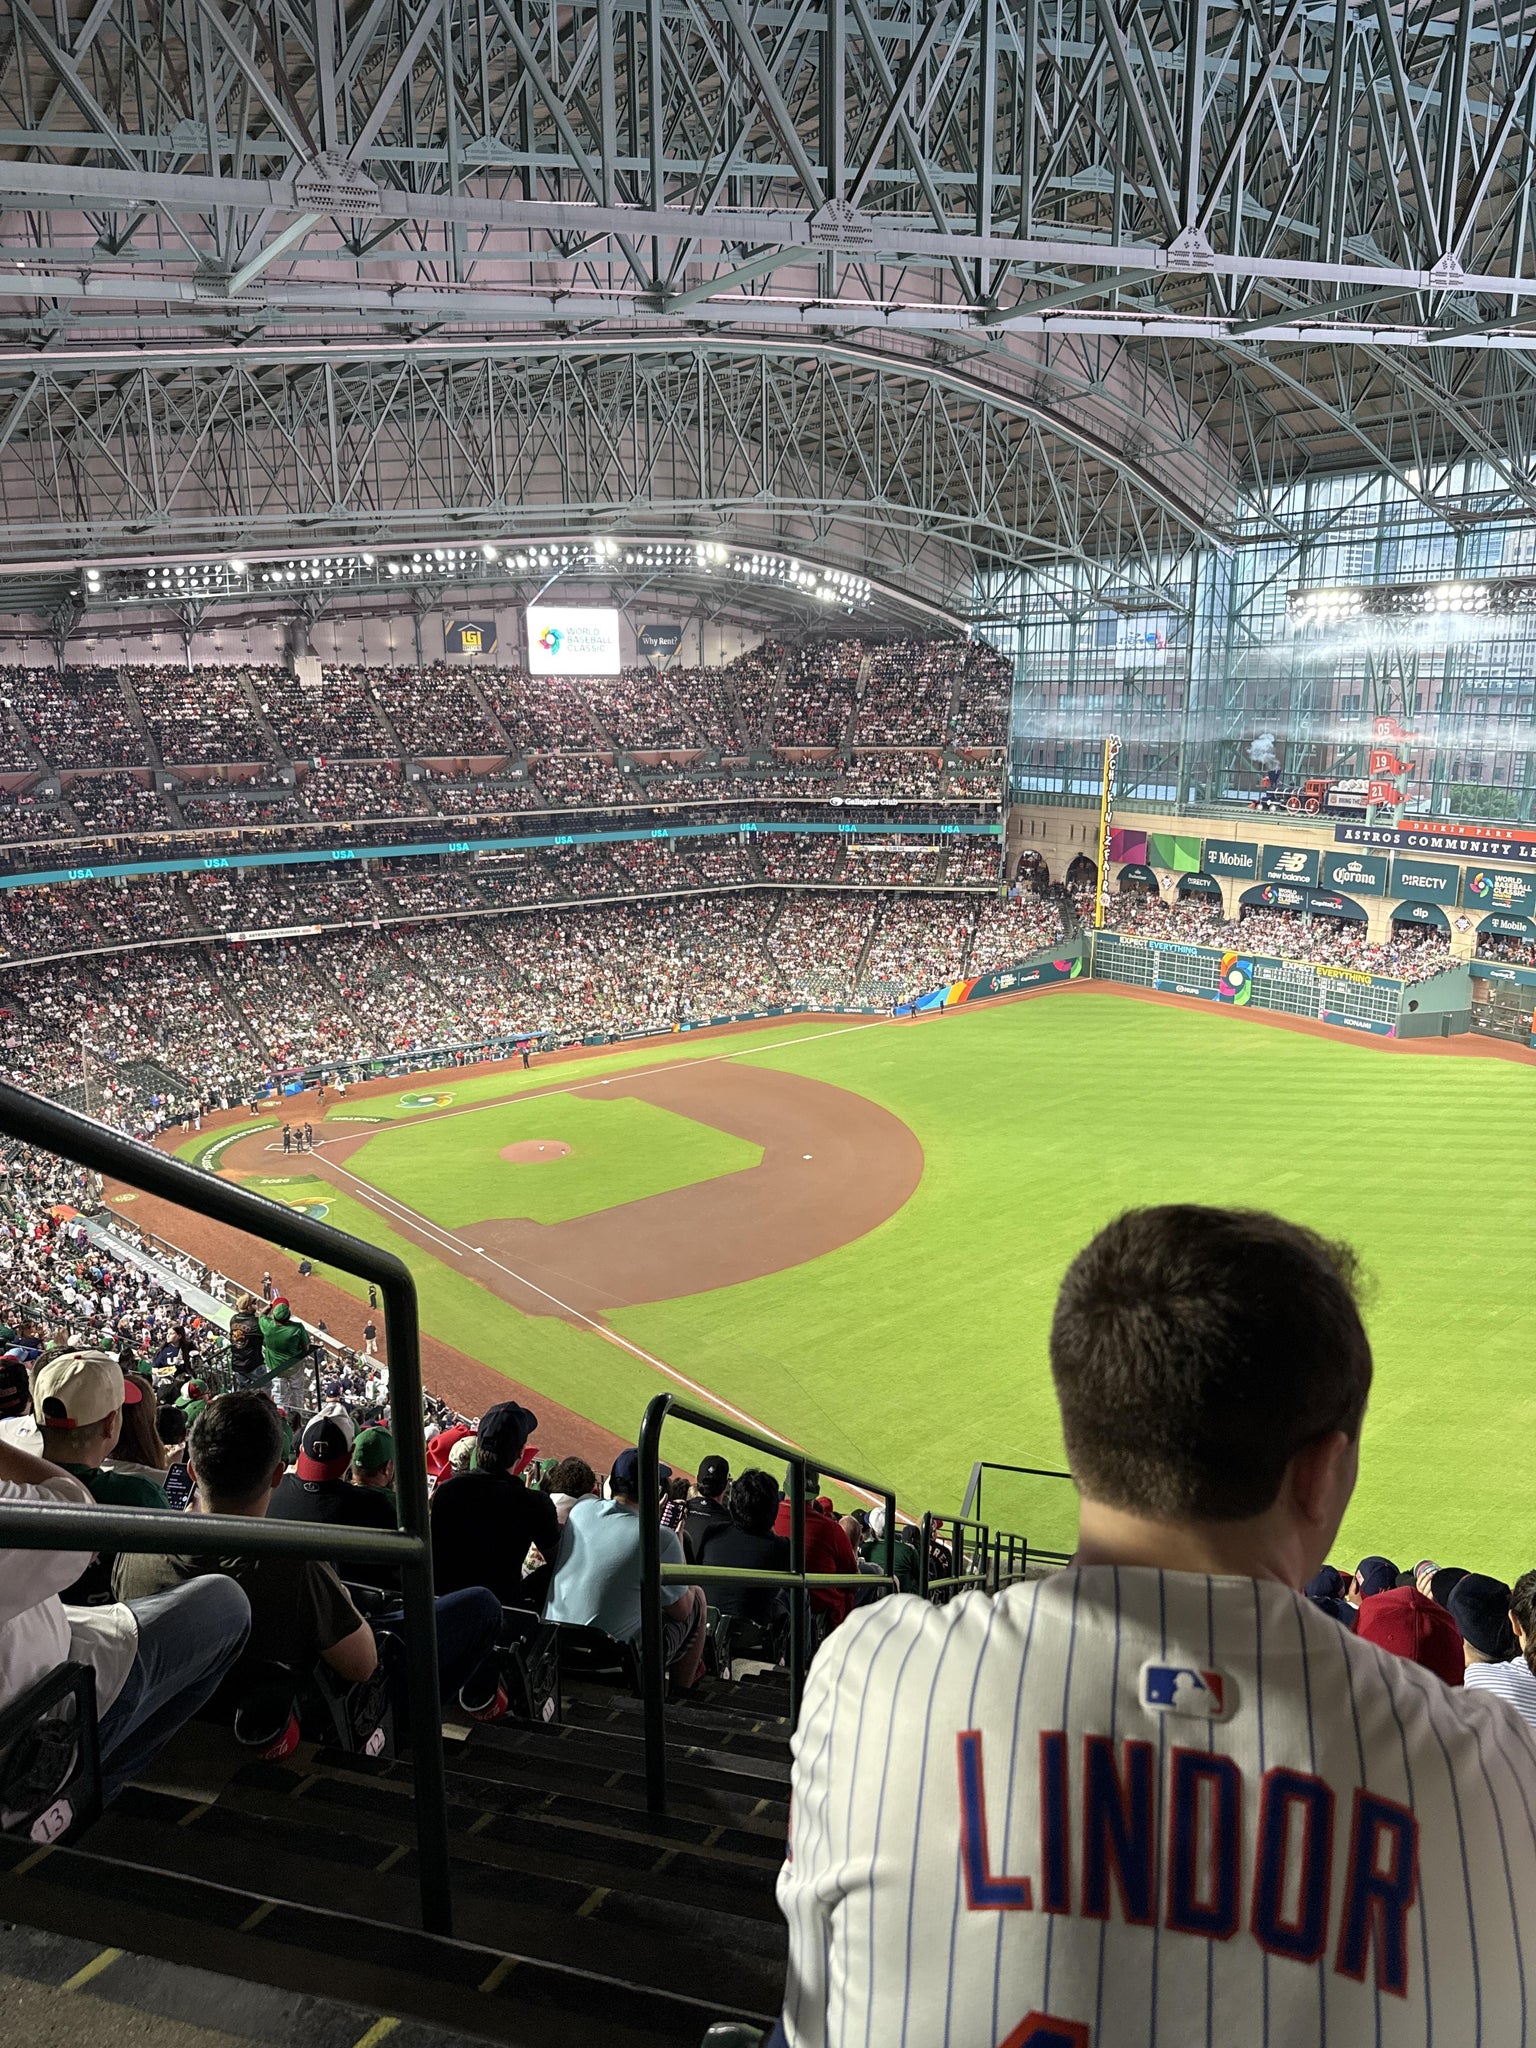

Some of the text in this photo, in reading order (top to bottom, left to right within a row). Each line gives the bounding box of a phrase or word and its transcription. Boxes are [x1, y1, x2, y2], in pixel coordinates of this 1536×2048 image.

[462, 631, 482, 645] LGI
[642, 636, 678, 646] Why Rent?
[1378, 723, 1390, 735] 05
[1376, 756, 1387, 767] 19
[1372, 786, 1383, 797] 21
[844, 798, 898, 807] Gallagher Club
[739, 823, 757, 831] USA
[838, 824, 857, 832] USA
[941, 825, 960, 833] USA
[1414, 823, 1513, 838] DAIKIN PARK
[651, 829, 669, 838] USA
[555, 836, 574, 845] USA
[1344, 829, 1400, 844] ASTROS
[1408, 836, 1512, 855] COMMUNITY
[449, 842, 470, 852] USA
[332, 850, 355, 860] USA
[204, 858, 229, 868] USA
[68, 868, 94, 880] USA
[1267, 872, 1311, 883] new balance
[1333, 867, 1376, 885] Corona
[1494, 875, 1523, 884] WORLD
[1187, 877, 1212, 887] DIRECTV
[1401, 874, 1447, 890] DIRECTV
[1493, 882, 1532, 892] BASEBALL
[1277, 892, 1304, 900] BASEBALL
[1493, 887, 1526, 897] CLASSIC
[1413, 907, 1429, 919] dip
[1120, 936, 1198, 955] EXPECT EVERYTHING
[1282, 961, 1316, 974] EXPECT
[1316, 967, 1372, 985] EVERYTHING
[1343, 1018, 1372, 1029] KONAMI
[370, 1733, 383, 1754] 12
[40, 1808, 65, 1841] 13
[957, 1729, 1420, 1998] LINDOR
